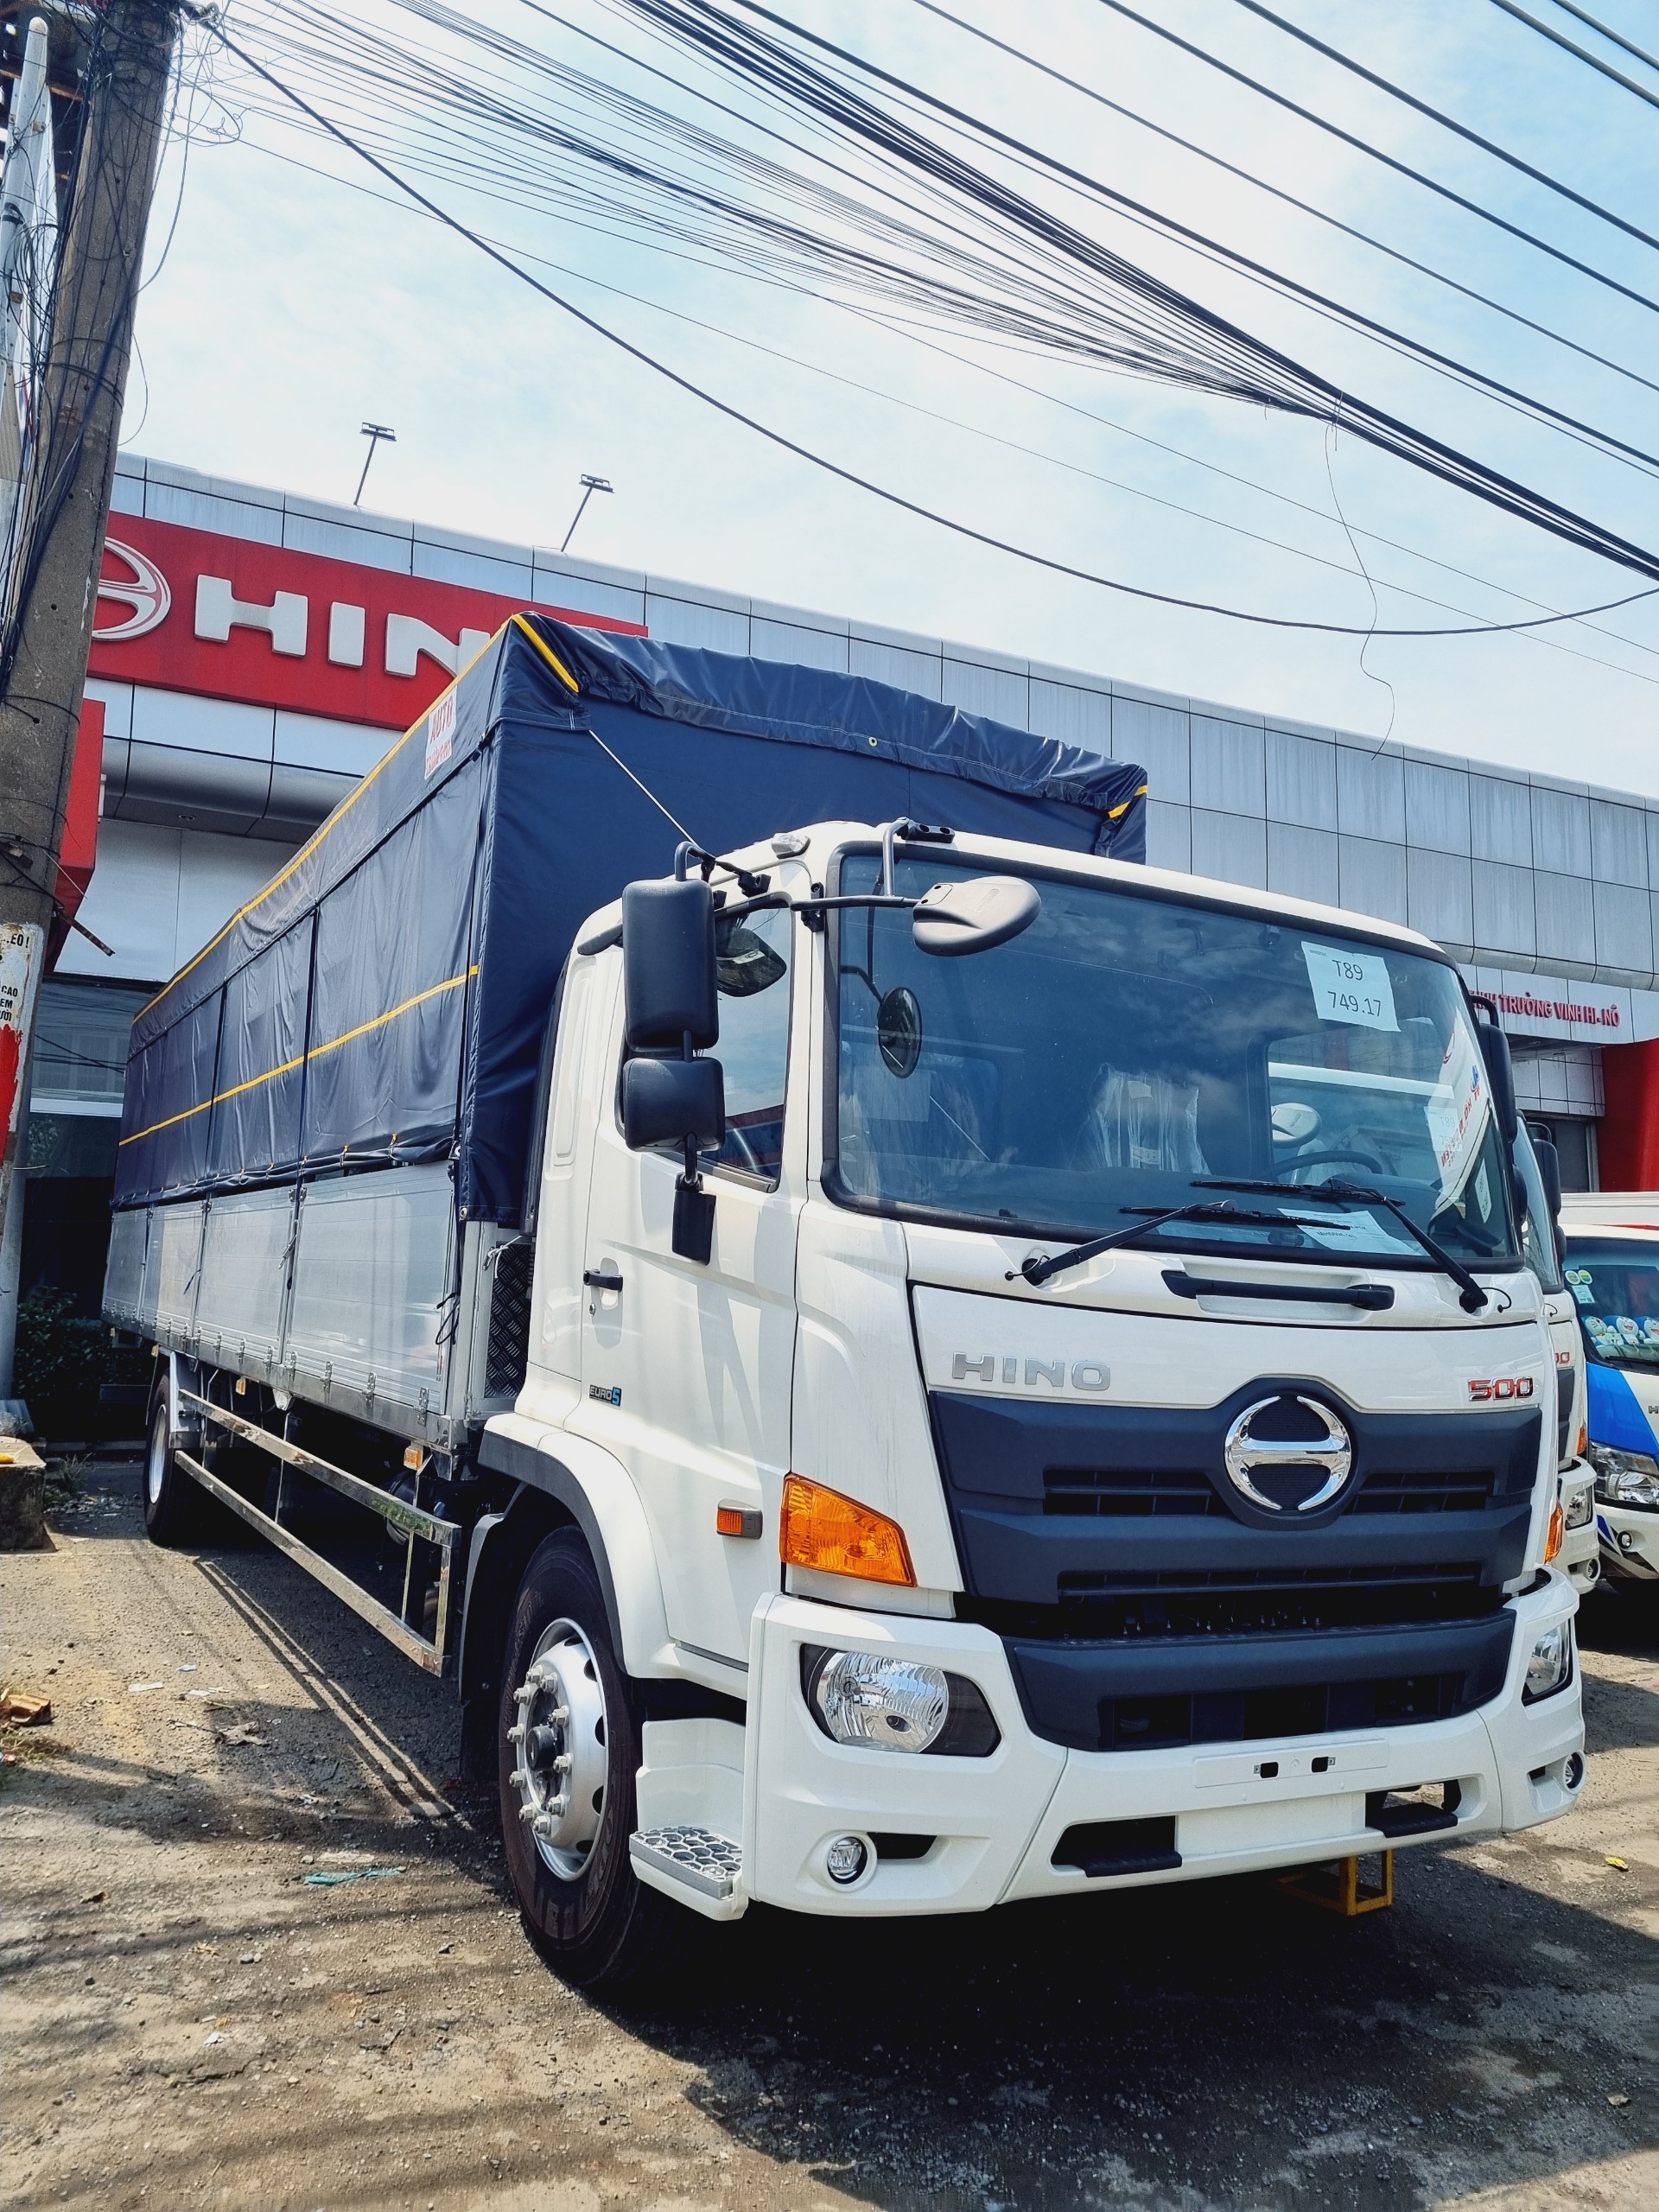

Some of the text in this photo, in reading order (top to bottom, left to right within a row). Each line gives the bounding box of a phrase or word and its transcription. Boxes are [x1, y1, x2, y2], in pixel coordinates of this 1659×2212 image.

[430, 696, 454, 744] AUTO
[1332, 959, 1363, 981] T89
[1327, 990, 1381, 1017] 749.17
[1500, 992, 1553, 1019] TRƯỜNG
[1554, 1002, 1583, 1022] VINH
[952, 1351, 1111, 1391] HINO
[1468, 1376, 1534, 1402] 500
